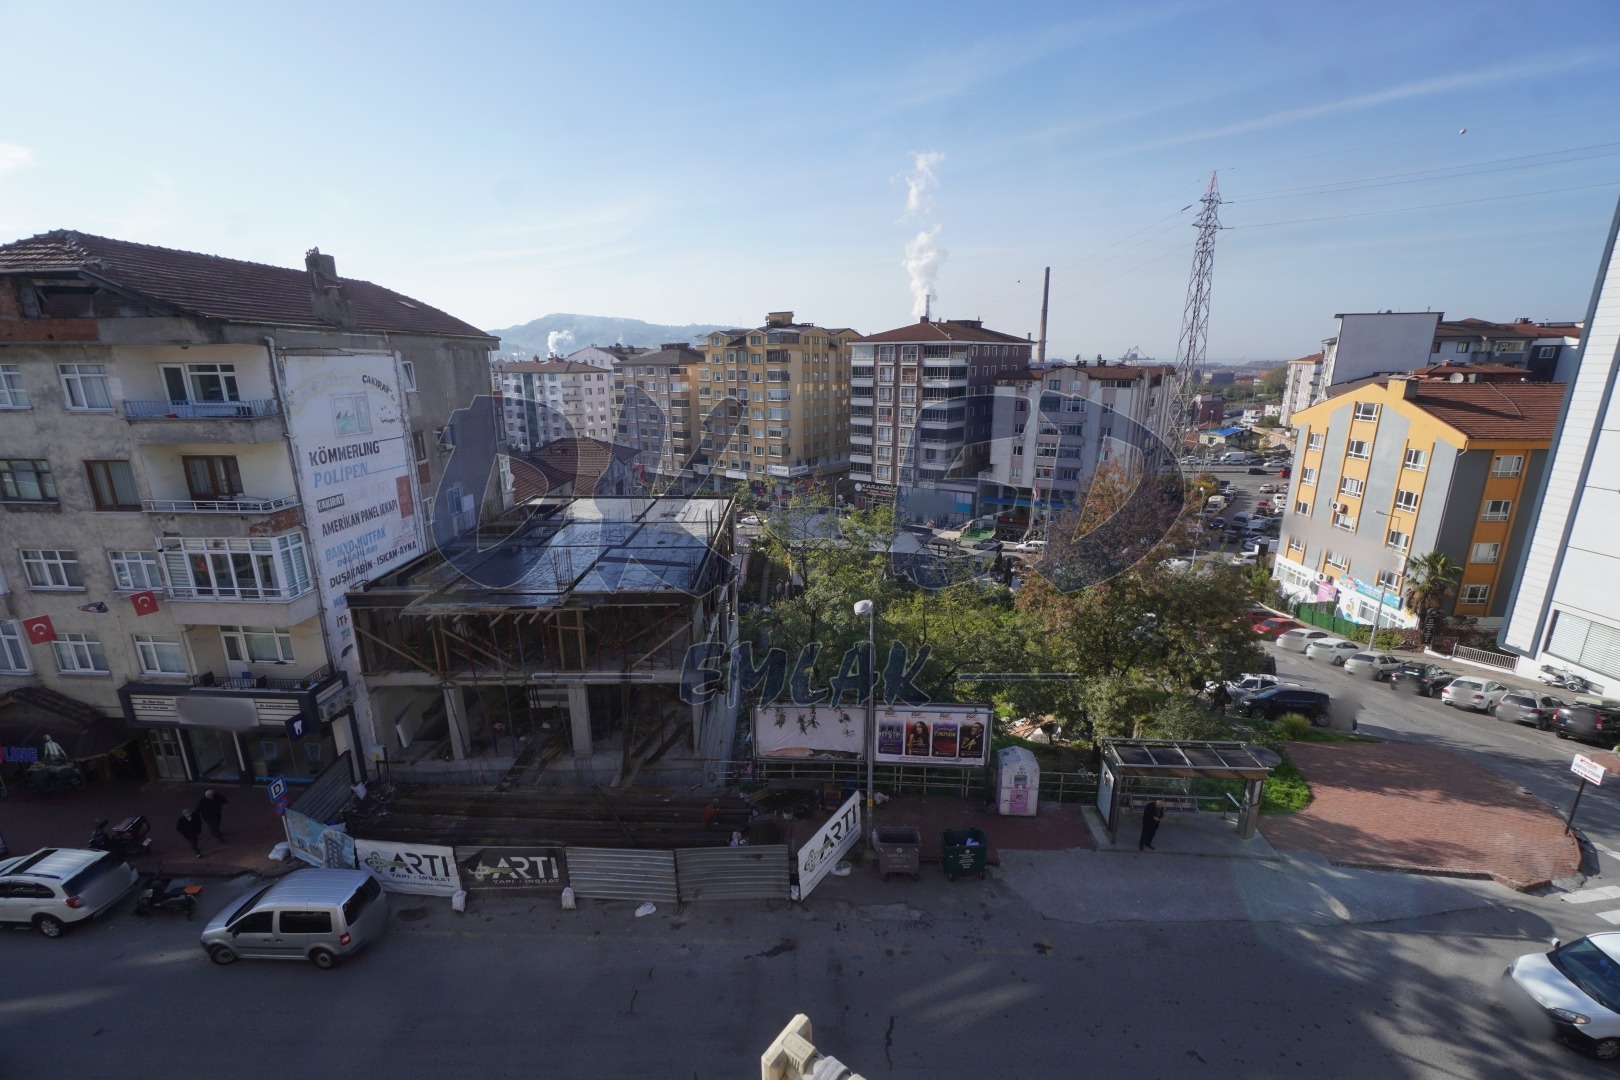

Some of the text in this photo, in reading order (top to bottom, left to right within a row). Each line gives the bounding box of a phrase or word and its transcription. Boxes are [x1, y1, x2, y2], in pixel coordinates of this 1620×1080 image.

[309, 440, 380, 467] KÖMMERLING
[314, 461, 369, 488] POLİPEN
[322, 514, 360, 537] AMERİKAN
[361, 505, 379, 523] PANEL
[273, 783, 281, 796] D
[820, 803, 857, 860] ARTI
[389, 852, 451, 877] ARTI
[492, 856, 560, 879] ARTI
